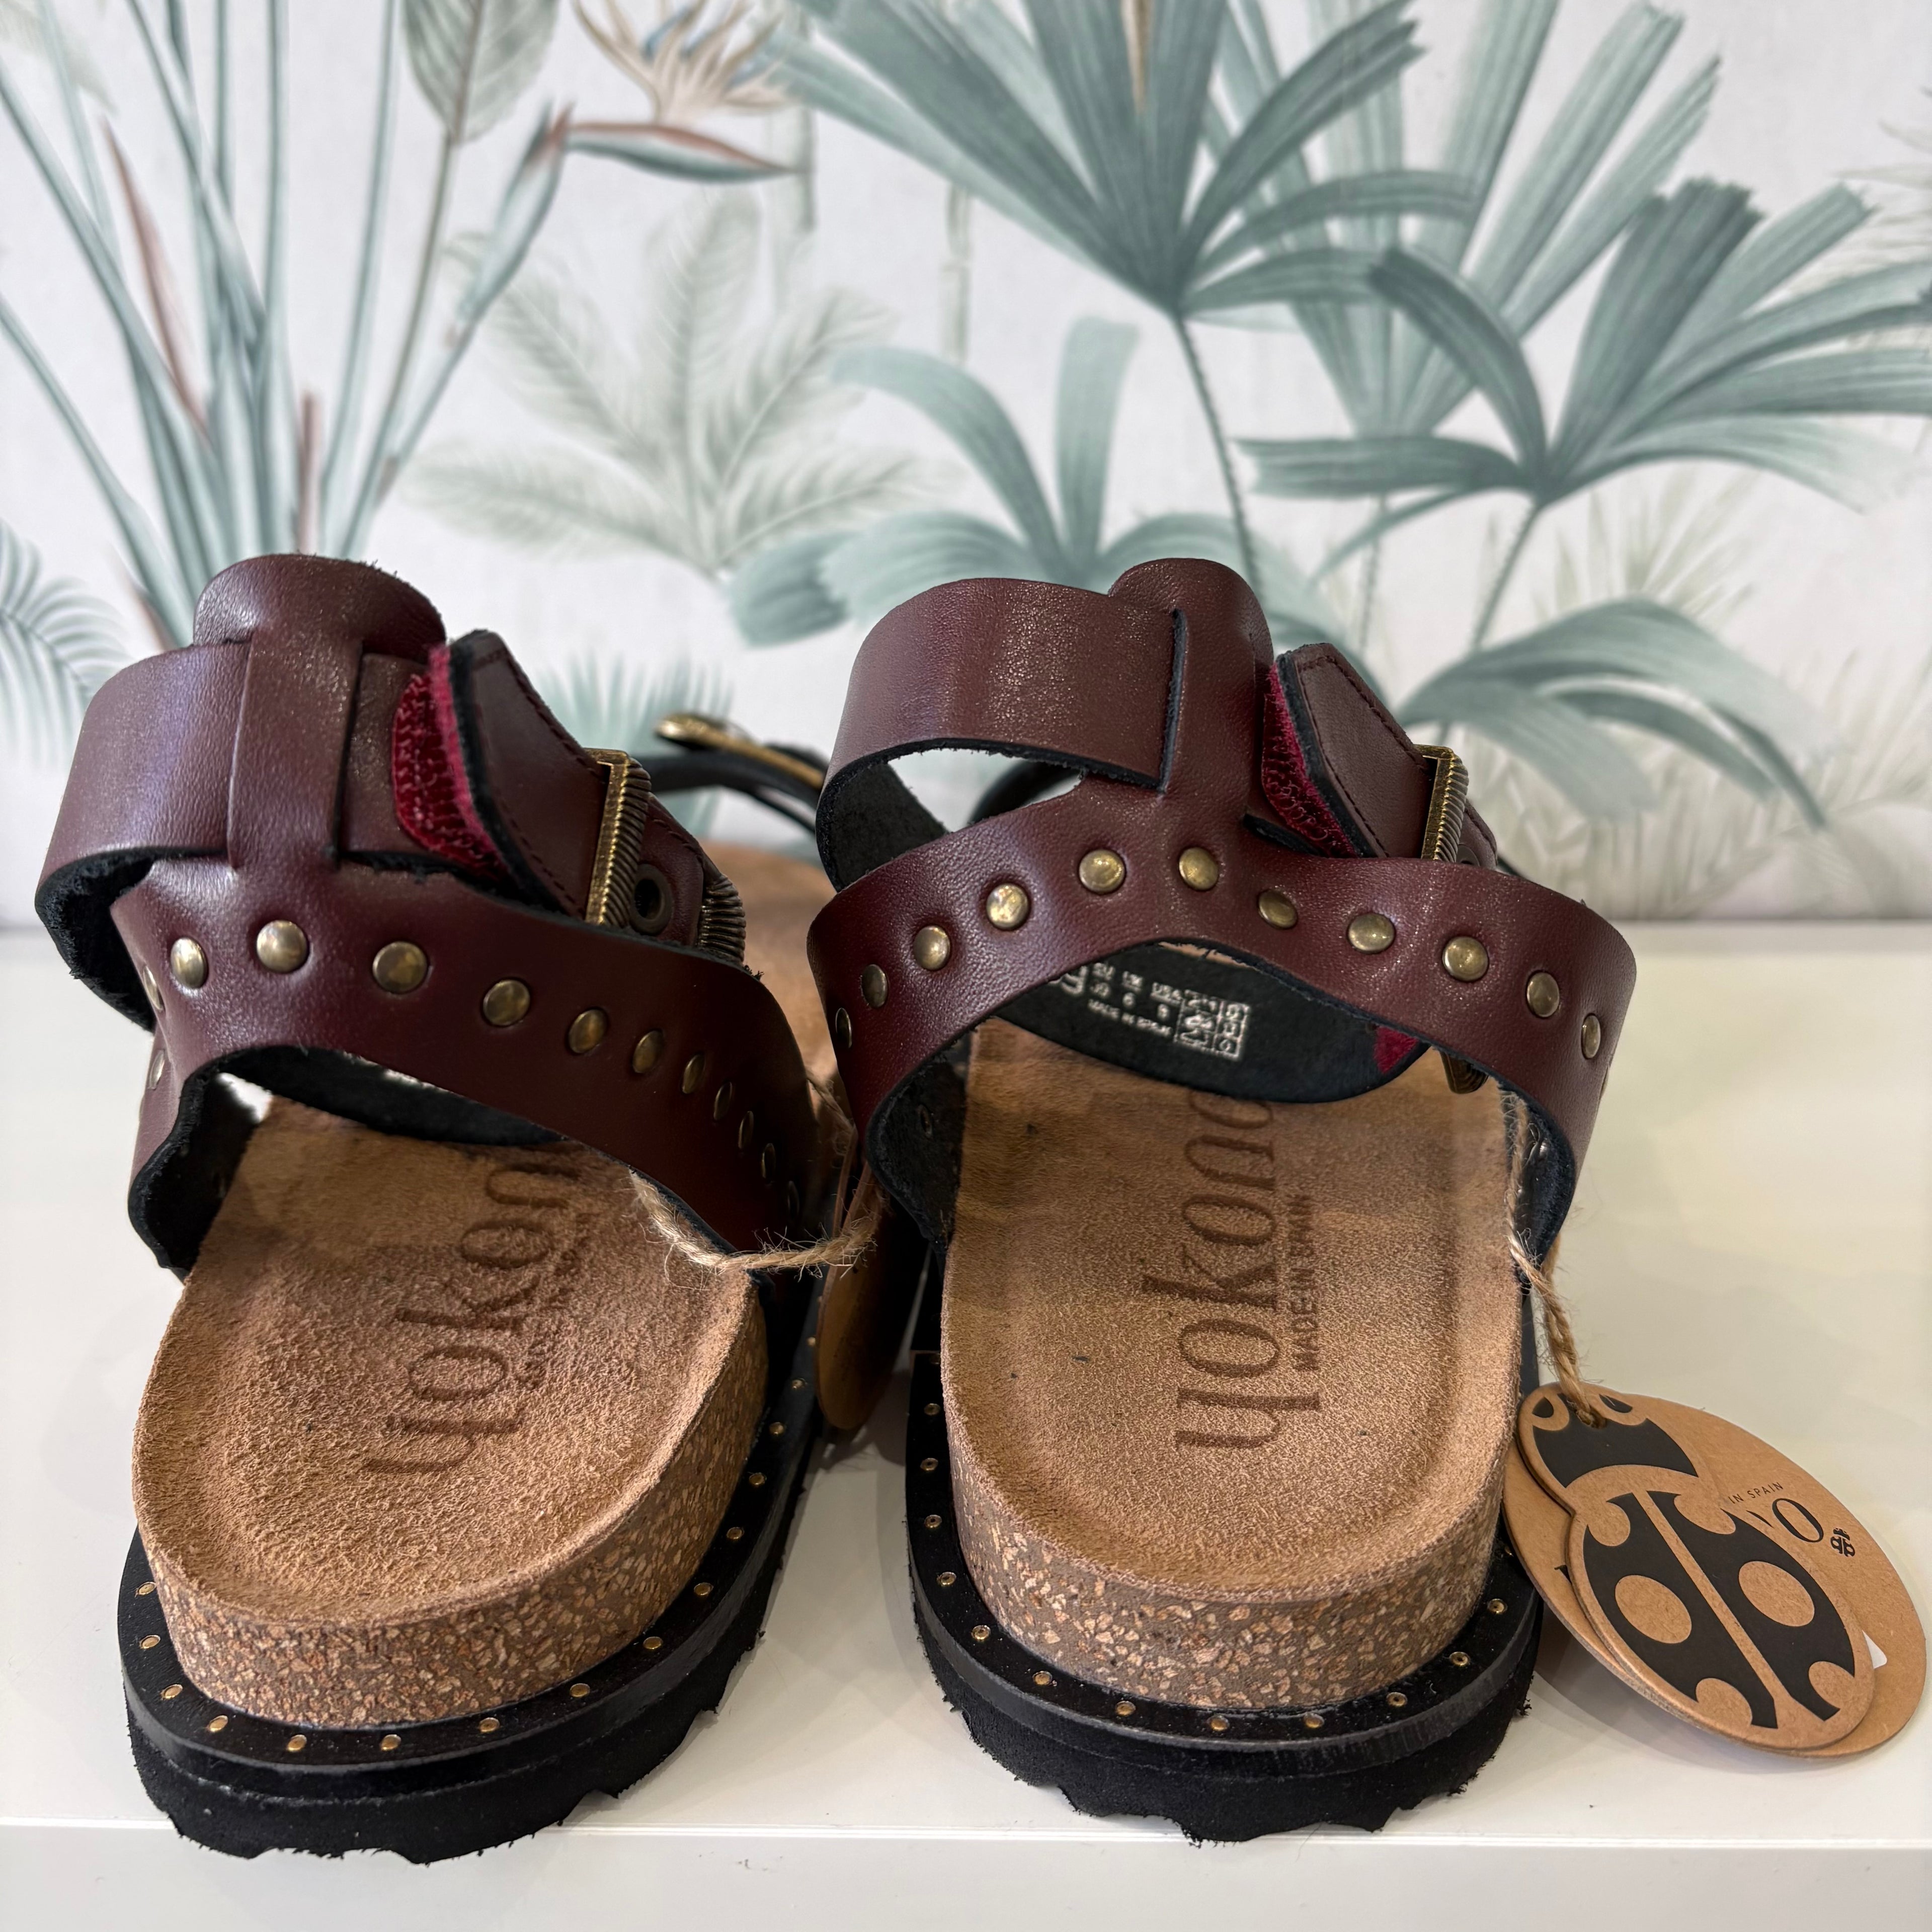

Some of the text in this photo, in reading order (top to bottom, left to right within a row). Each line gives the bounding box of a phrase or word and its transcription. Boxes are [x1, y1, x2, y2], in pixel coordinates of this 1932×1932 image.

[1150, 982, 1182, 1004] USA
[359, 1146, 584, 1475] yokon
[1286, 1193, 1321, 1372] MADE IN SPAIN
[1728, 1482, 1783, 1504] IN SPAIN
